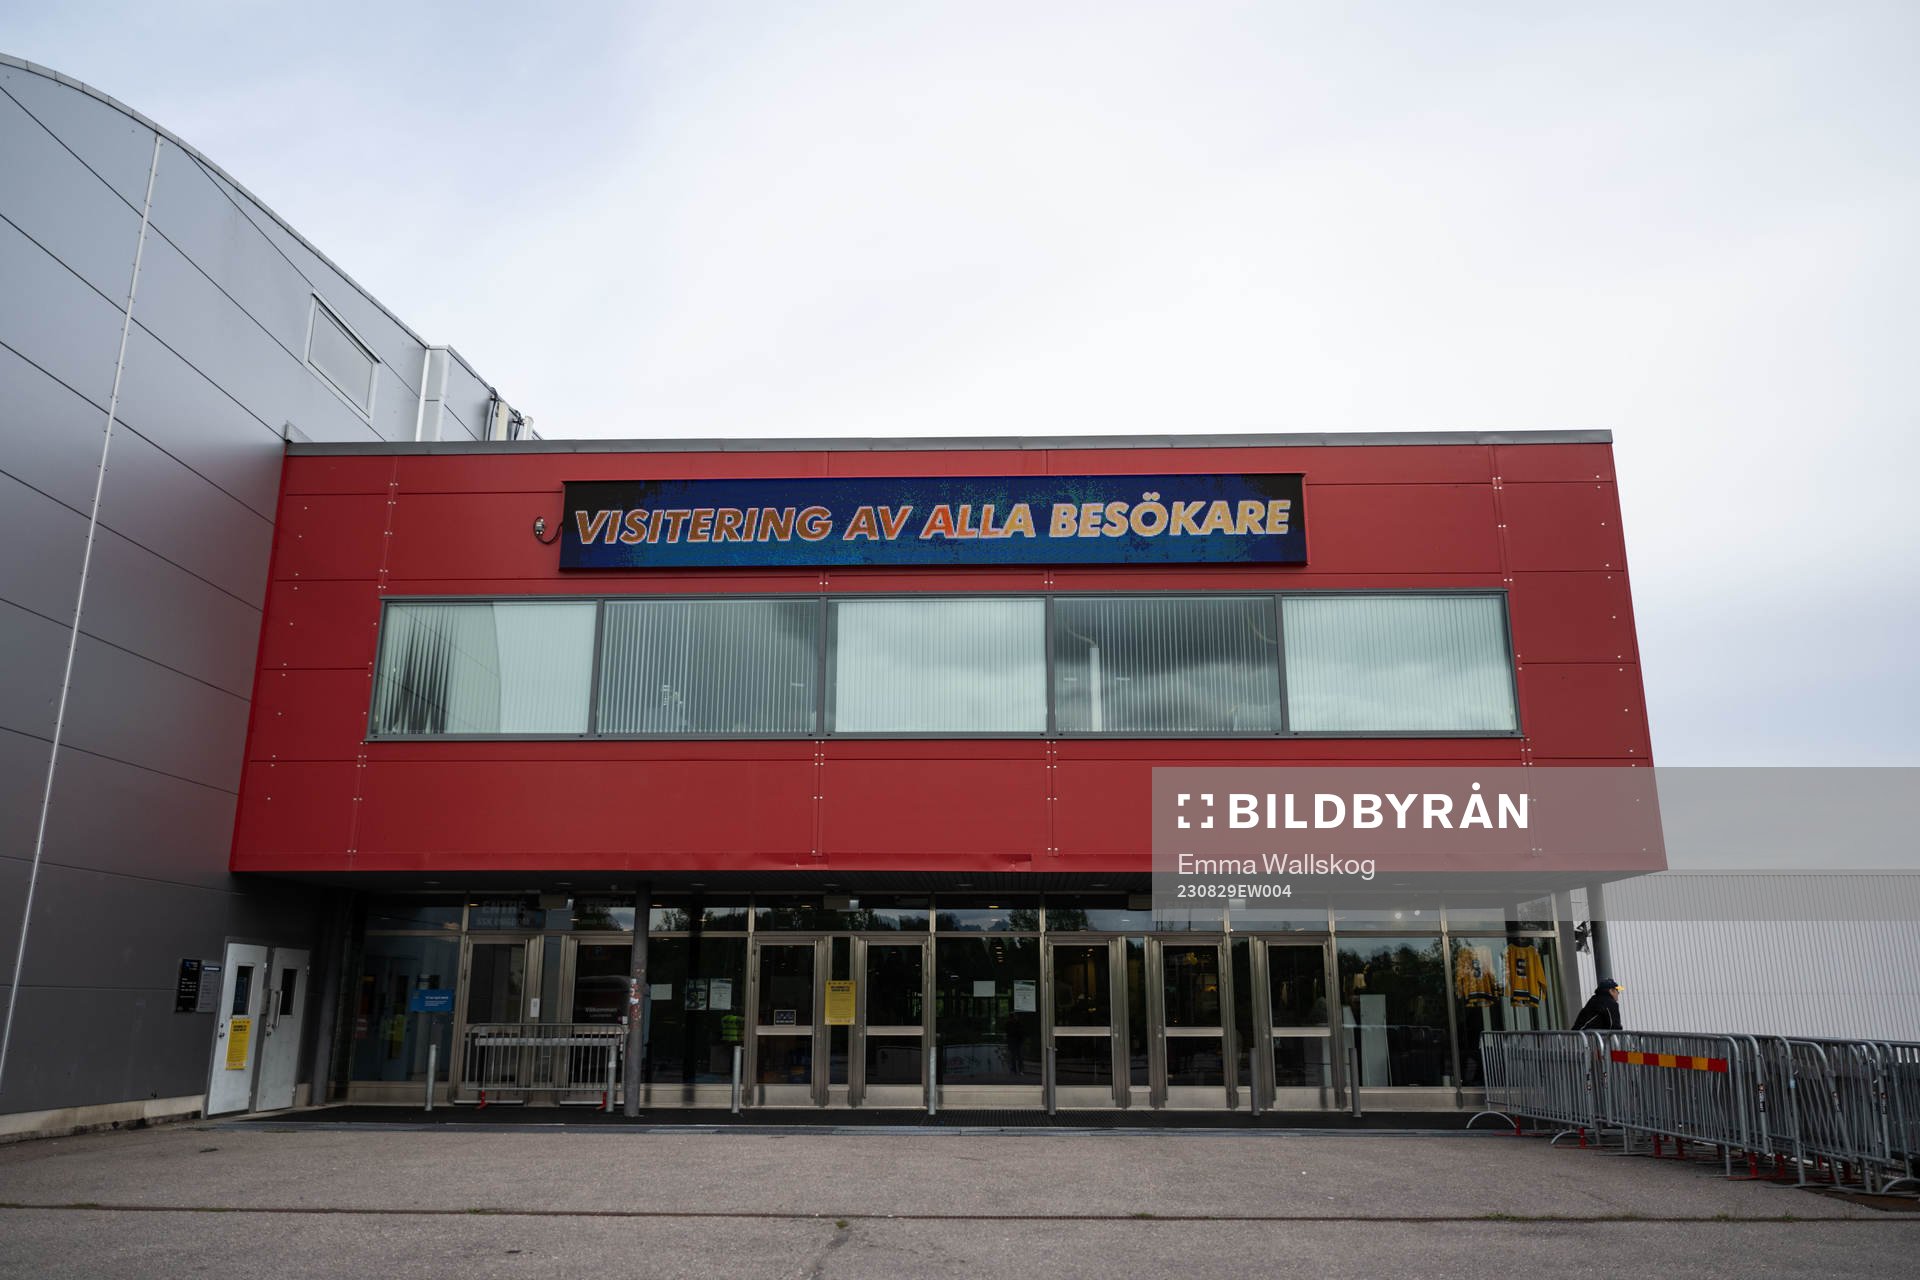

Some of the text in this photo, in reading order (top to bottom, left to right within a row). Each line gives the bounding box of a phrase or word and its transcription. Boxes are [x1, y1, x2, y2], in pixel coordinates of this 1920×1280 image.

[575, 491, 1292, 545] VISITERING AV ALLA BESÖKARE
